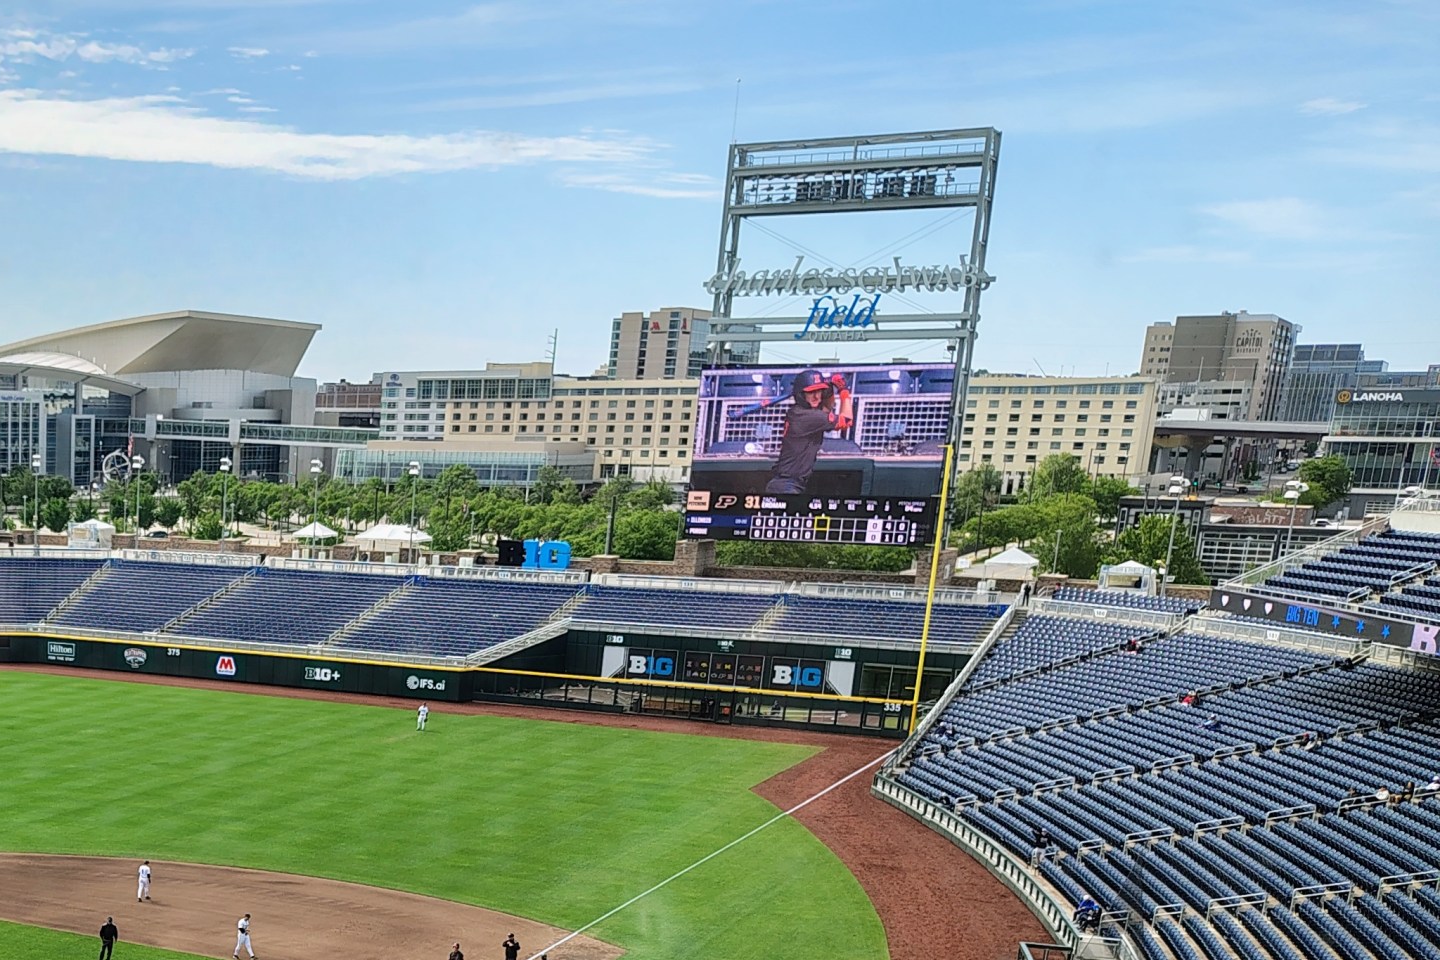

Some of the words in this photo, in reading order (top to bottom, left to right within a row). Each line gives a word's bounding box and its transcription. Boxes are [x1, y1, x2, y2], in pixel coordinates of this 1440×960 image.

[795, 294, 881, 340] field
[809, 330, 868, 341] OMAHA
[1353, 392, 1403, 402] LANOHA
[744, 496, 760, 509] 31
[1248, 514, 1285, 524] BLATT
[1285, 605, 1301, 623] BIG
[1303, 607, 1320, 627] TEN
[49, 644, 73, 654] Hilton
[419, 679, 446, 691] IFS.ai
[883, 702, 901, 712] 335
